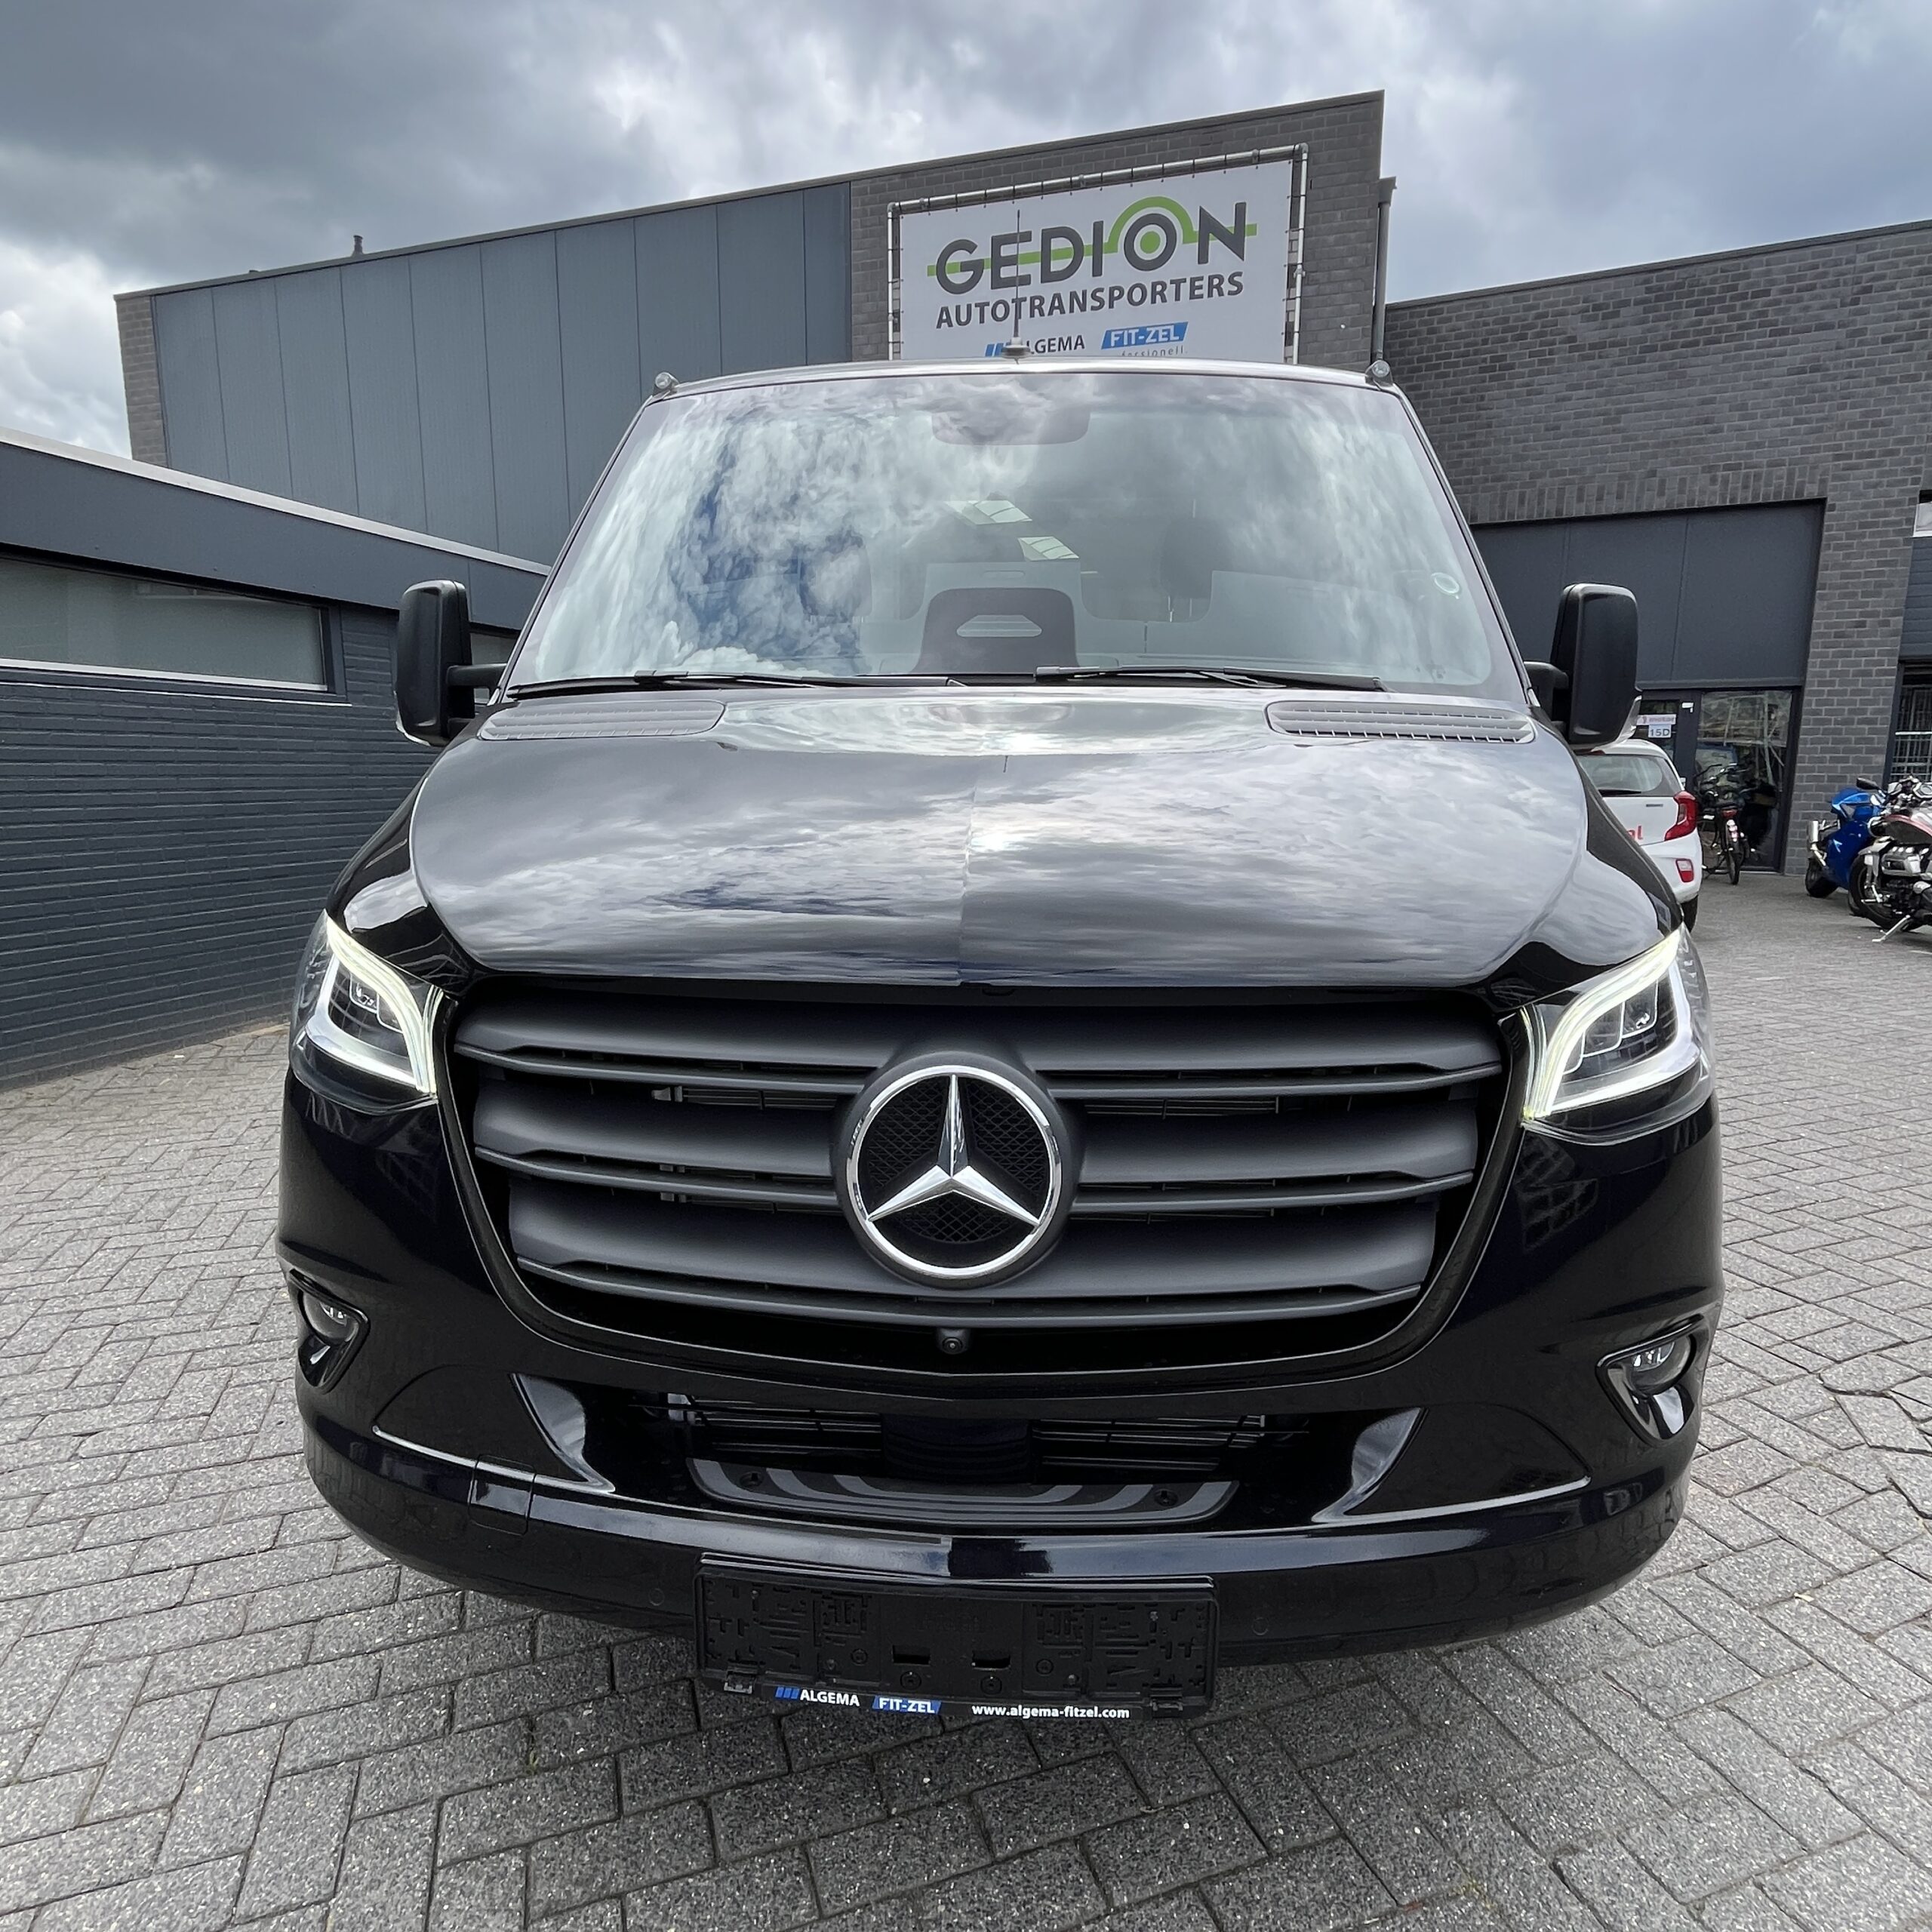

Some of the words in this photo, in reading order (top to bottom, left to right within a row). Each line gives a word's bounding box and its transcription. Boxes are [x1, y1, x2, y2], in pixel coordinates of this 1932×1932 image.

[936, 202, 1247, 294] GEDION
[936, 271, 1244, 329] AUTOTRANSPORTERS
[1110, 325, 1180, 346] FIT-ZEL
[1650, 728, 1670, 737] 15D
[800, 1689, 860, 1706] ALGEMA
[879, 1698, 935, 1713] FIT-ZEL
[972, 1705, 1130, 1719] www.algema-fitzel.com
